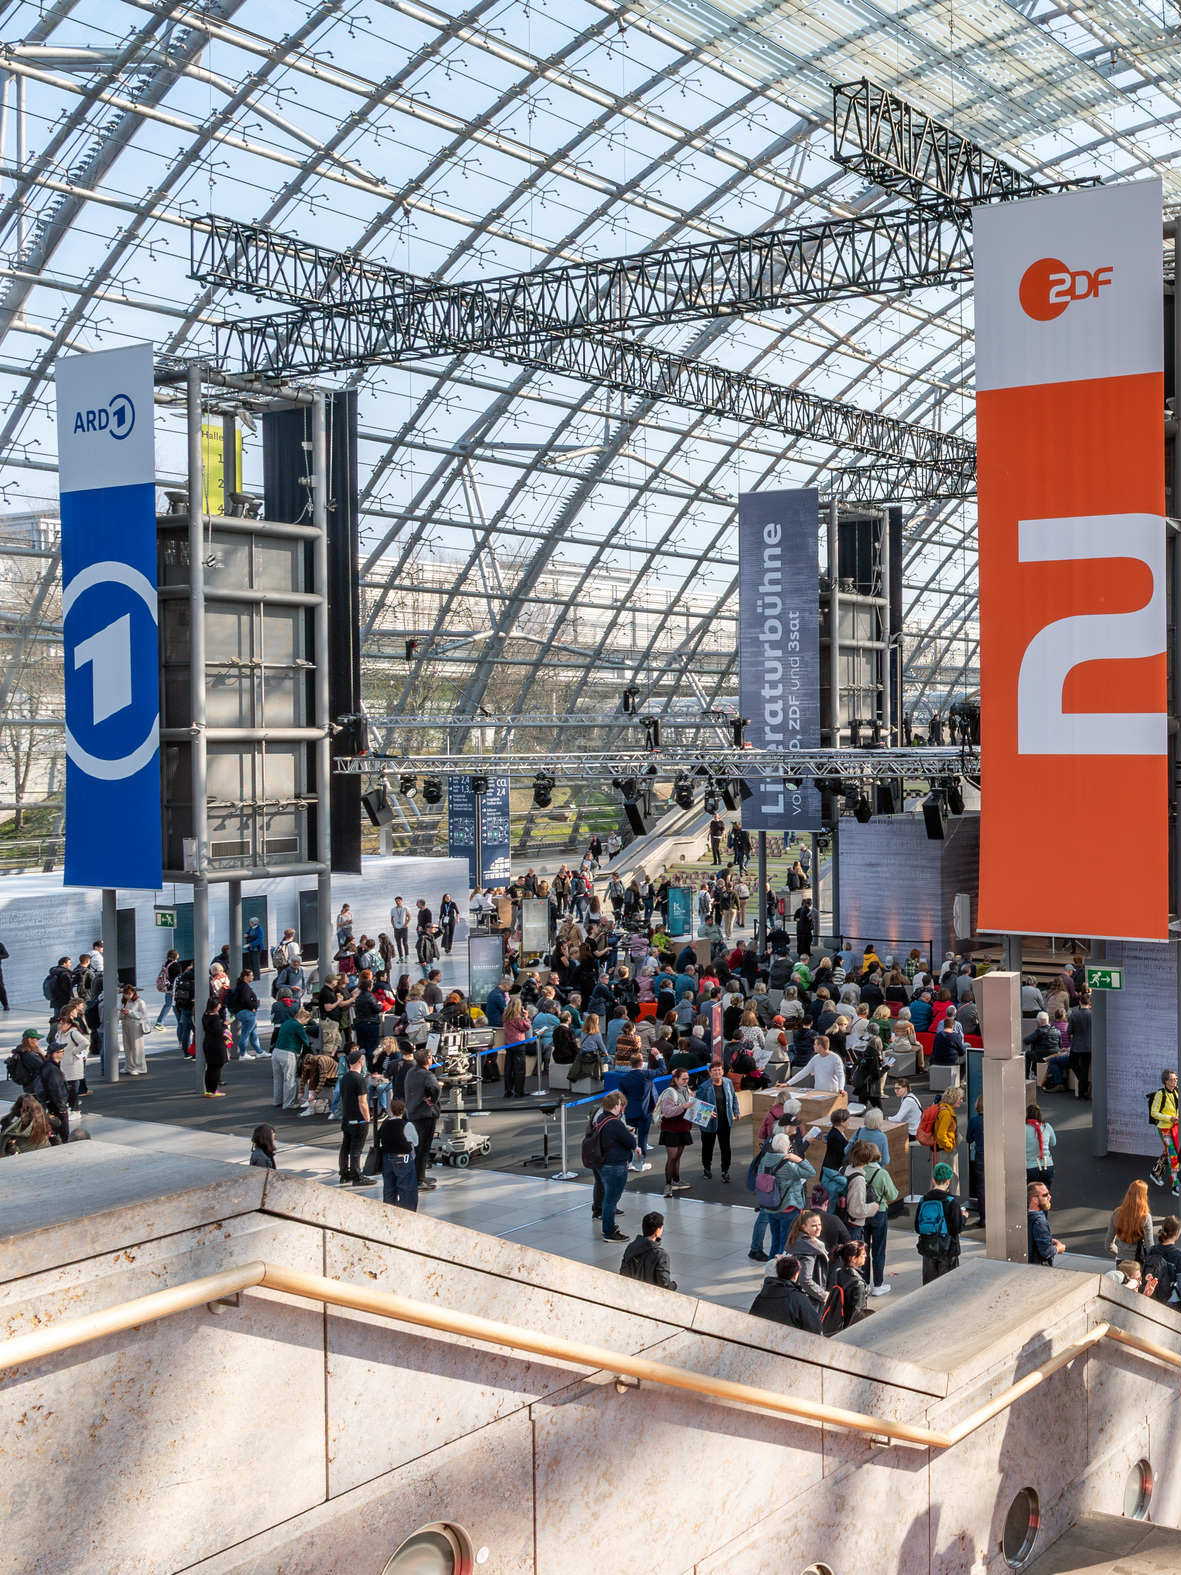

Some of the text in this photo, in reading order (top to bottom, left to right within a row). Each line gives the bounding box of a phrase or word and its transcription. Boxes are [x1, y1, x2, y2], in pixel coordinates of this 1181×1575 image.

[1049, 265, 1114, 304] ZDF
[73, 408, 110, 434] ARD
[788, 611, 800, 652] 3sat
[1017, 513, 1168, 755] 2
[73, 612, 132, 726] 1
[788, 656, 800, 690] und
[788, 695, 800, 730] ZDF
[496, 779, 507, 787] CCL
[496, 788, 506, 796] 2,4
